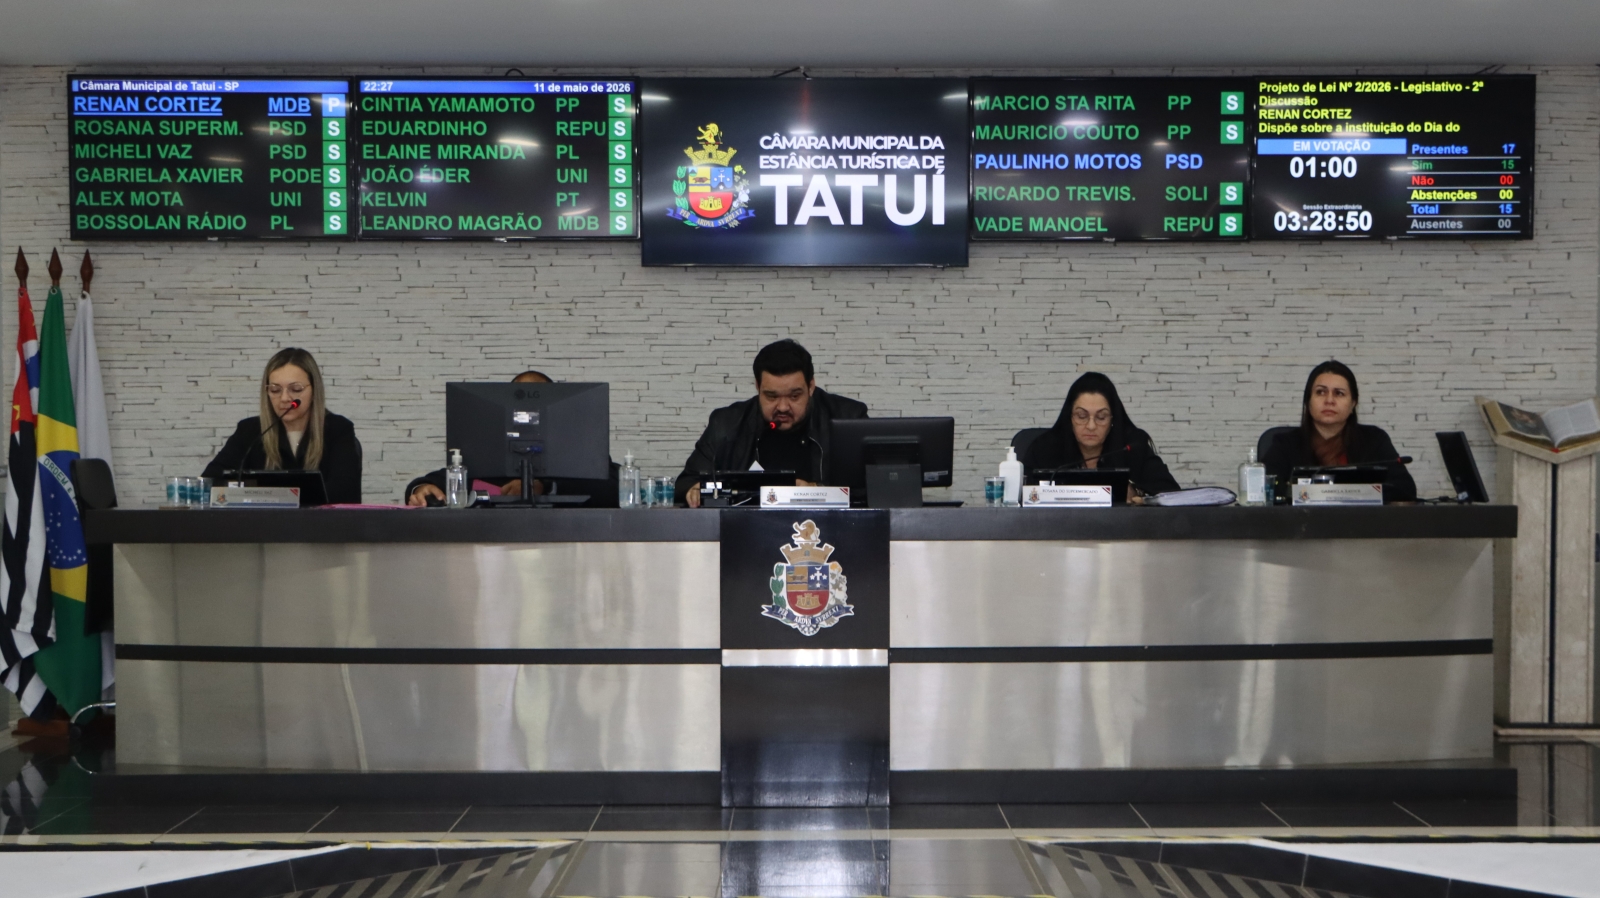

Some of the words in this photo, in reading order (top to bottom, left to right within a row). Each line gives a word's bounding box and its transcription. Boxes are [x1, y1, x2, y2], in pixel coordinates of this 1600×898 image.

[80, 81, 120, 91] Câmara
[122, 81, 172, 93] Municipal
[175, 81, 188, 91] de
[190, 81, 216, 91] Tatuí
[224, 82, 239, 91] SP
[364, 82, 393, 91] 22:27
[534, 84, 544, 92] 11
[548, 83, 560, 92] de
[563, 83, 589, 92] maio
[591, 83, 604, 92] de
[606, 83, 631, 92] 2026
[1259, 83, 1299, 94] Projeto
[1302, 83, 1316, 92] de
[1320, 83, 1336, 92] Lei
[1355, 82, 1391, 92] 2/2026
[1401, 83, 1462, 94] Legislativo
[74, 96, 139, 112] RENAN
[145, 96, 222, 112] CORTEZ
[268, 97, 311, 113] MDB
[328, 98, 340, 112] P
[361, 97, 423, 113] CINTIA
[427, 97, 535, 113] YAMAMOTO
[556, 98, 580, 113] PP
[614, 98, 626, 113] S
[975, 96, 1050, 111] MARCIO
[1055, 96, 1090, 111] STA
[1095, 96, 1136, 111] RITA
[1168, 96, 1192, 111] PP
[1226, 95, 1238, 110] S
[1259, 96, 1318, 106] Discussão
[1259, 109, 1300, 119] RENAN
[1303, 109, 1352, 119] CORTEZ
[74, 121, 154, 136] ROSANA
[159, 121, 243, 136] SUPERM.
[269, 122, 306, 136] PSD
[328, 121, 340, 136] S
[362, 121, 487, 136] EDUARDINHO
[556, 122, 606, 136] REPU
[614, 121, 626, 136] S
[975, 125, 1067, 140] MAURICIO
[1073, 125, 1140, 140] COUTO
[1168, 126, 1192, 140] PP
[1226, 125, 1238, 140] S
[1259, 123, 1298, 135] Dispõe
[1300, 123, 1333, 133] sobre
[1336, 125, 1342, 133] a
[1346, 123, 1404, 134] instituição
[1407, 123, 1421, 133] do
[1424, 123, 1442, 133] Dia
[1446, 123, 1460, 132] do
[759, 133, 830, 150] CÂMARA
[832, 136, 919, 150] MUNICIPAL
[920, 136, 945, 150] DA
[1293, 141, 1311, 152] EM
[1314, 140, 1371, 153] VOTAÇÃO
[75, 144, 151, 159] MICHELI
[157, 144, 193, 159] VAZ
[269, 144, 307, 160] PSD
[328, 144, 340, 160] S
[362, 144, 432, 160] ELAINE
[438, 144, 526, 160] MIRANDA
[556, 145, 579, 160] PL
[614, 145, 626, 160] S
[1411, 144, 1468, 155] Presentes
[1502, 144, 1515, 154] 17
[759, 152, 838, 169] ESTÂNCIA
[840, 152, 920, 168] TURÍSTICA
[922, 155, 945, 168] DE
[974, 154, 1069, 169] PAULINHO
[1074, 154, 1142, 169] MOTOS
[1165, 154, 1203, 169] PSD
[1290, 156, 1358, 178] 01:00
[1411, 160, 1433, 170] Sim
[1501, 160, 1514, 170] 15
[76, 168, 172, 183] GABRIELA
[177, 168, 243, 183] XAVIER
[270, 168, 322, 183] PODE
[328, 168, 340, 183] S
[361, 166, 414, 183] JOÃO
[420, 165, 470, 183] ÉDER
[556, 168, 588, 183] UNI
[614, 168, 626, 183] S
[1411, 176, 1434, 186] Não
[1500, 176, 1513, 185] 00
[76, 191, 124, 206] ALEX
[130, 191, 184, 206] MOTA
[270, 192, 301, 207] UNI
[328, 192, 341, 207] S
[361, 192, 427, 207] KELVIN
[556, 192, 579, 207] PT
[615, 192, 626, 207] S
[760, 167, 945, 226] TATUÍ
[974, 186, 1060, 201] RICARDO
[1066, 186, 1136, 201] TREVIS.
[1165, 186, 1208, 202] SOLI
[1225, 186, 1237, 201] S
[1411, 190, 1477, 201] Abstenções
[1499, 190, 1513, 200] 00
[1411, 204, 1439, 214] Total
[1499, 204, 1512, 214] 15
[77, 215, 181, 230] BOSSOLAN
[187, 212, 246, 230] RÁDIO
[271, 216, 294, 230] PL
[329, 216, 342, 231] S
[361, 216, 453, 231] LEANDRO
[458, 213, 542, 231] MAGRÃO
[558, 216, 599, 231] MDB
[615, 216, 627, 231] S
[974, 217, 1023, 232] VADE
[1029, 217, 1108, 232] MANOEL
[1164, 217, 1214, 232] REPU
[1225, 217, 1237, 232] S
[1274, 211, 1372, 232] 03:28:50
[1410, 219, 1463, 229] Ausentes
[1498, 219, 1511, 228] 00
